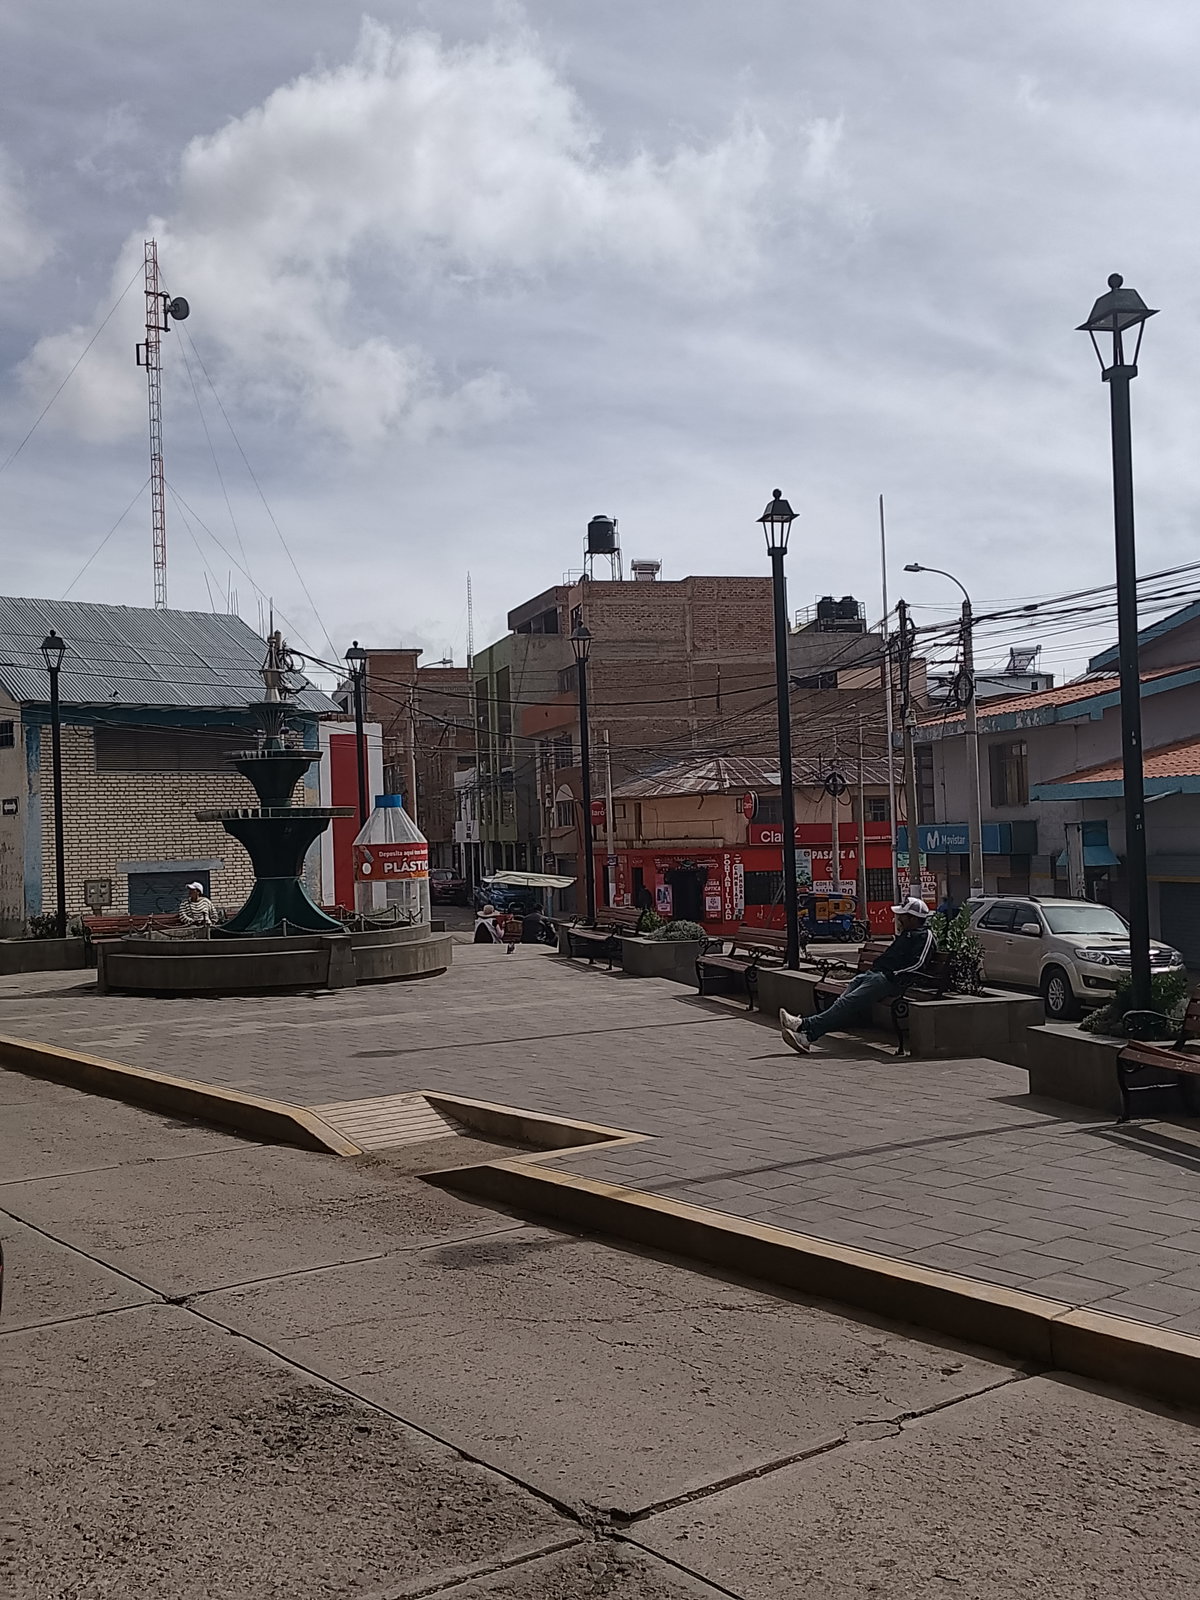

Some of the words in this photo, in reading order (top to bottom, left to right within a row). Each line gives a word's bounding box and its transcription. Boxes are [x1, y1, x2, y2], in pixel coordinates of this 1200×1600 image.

[760, 831, 784, 842] Cla
[941, 834, 966, 845] Movistar
[379, 850, 402, 858] Deposita
[812, 850, 846, 859] PASAE
[849, 850, 856, 859] A
[724, 854, 732, 920] PORTABILIDAD
